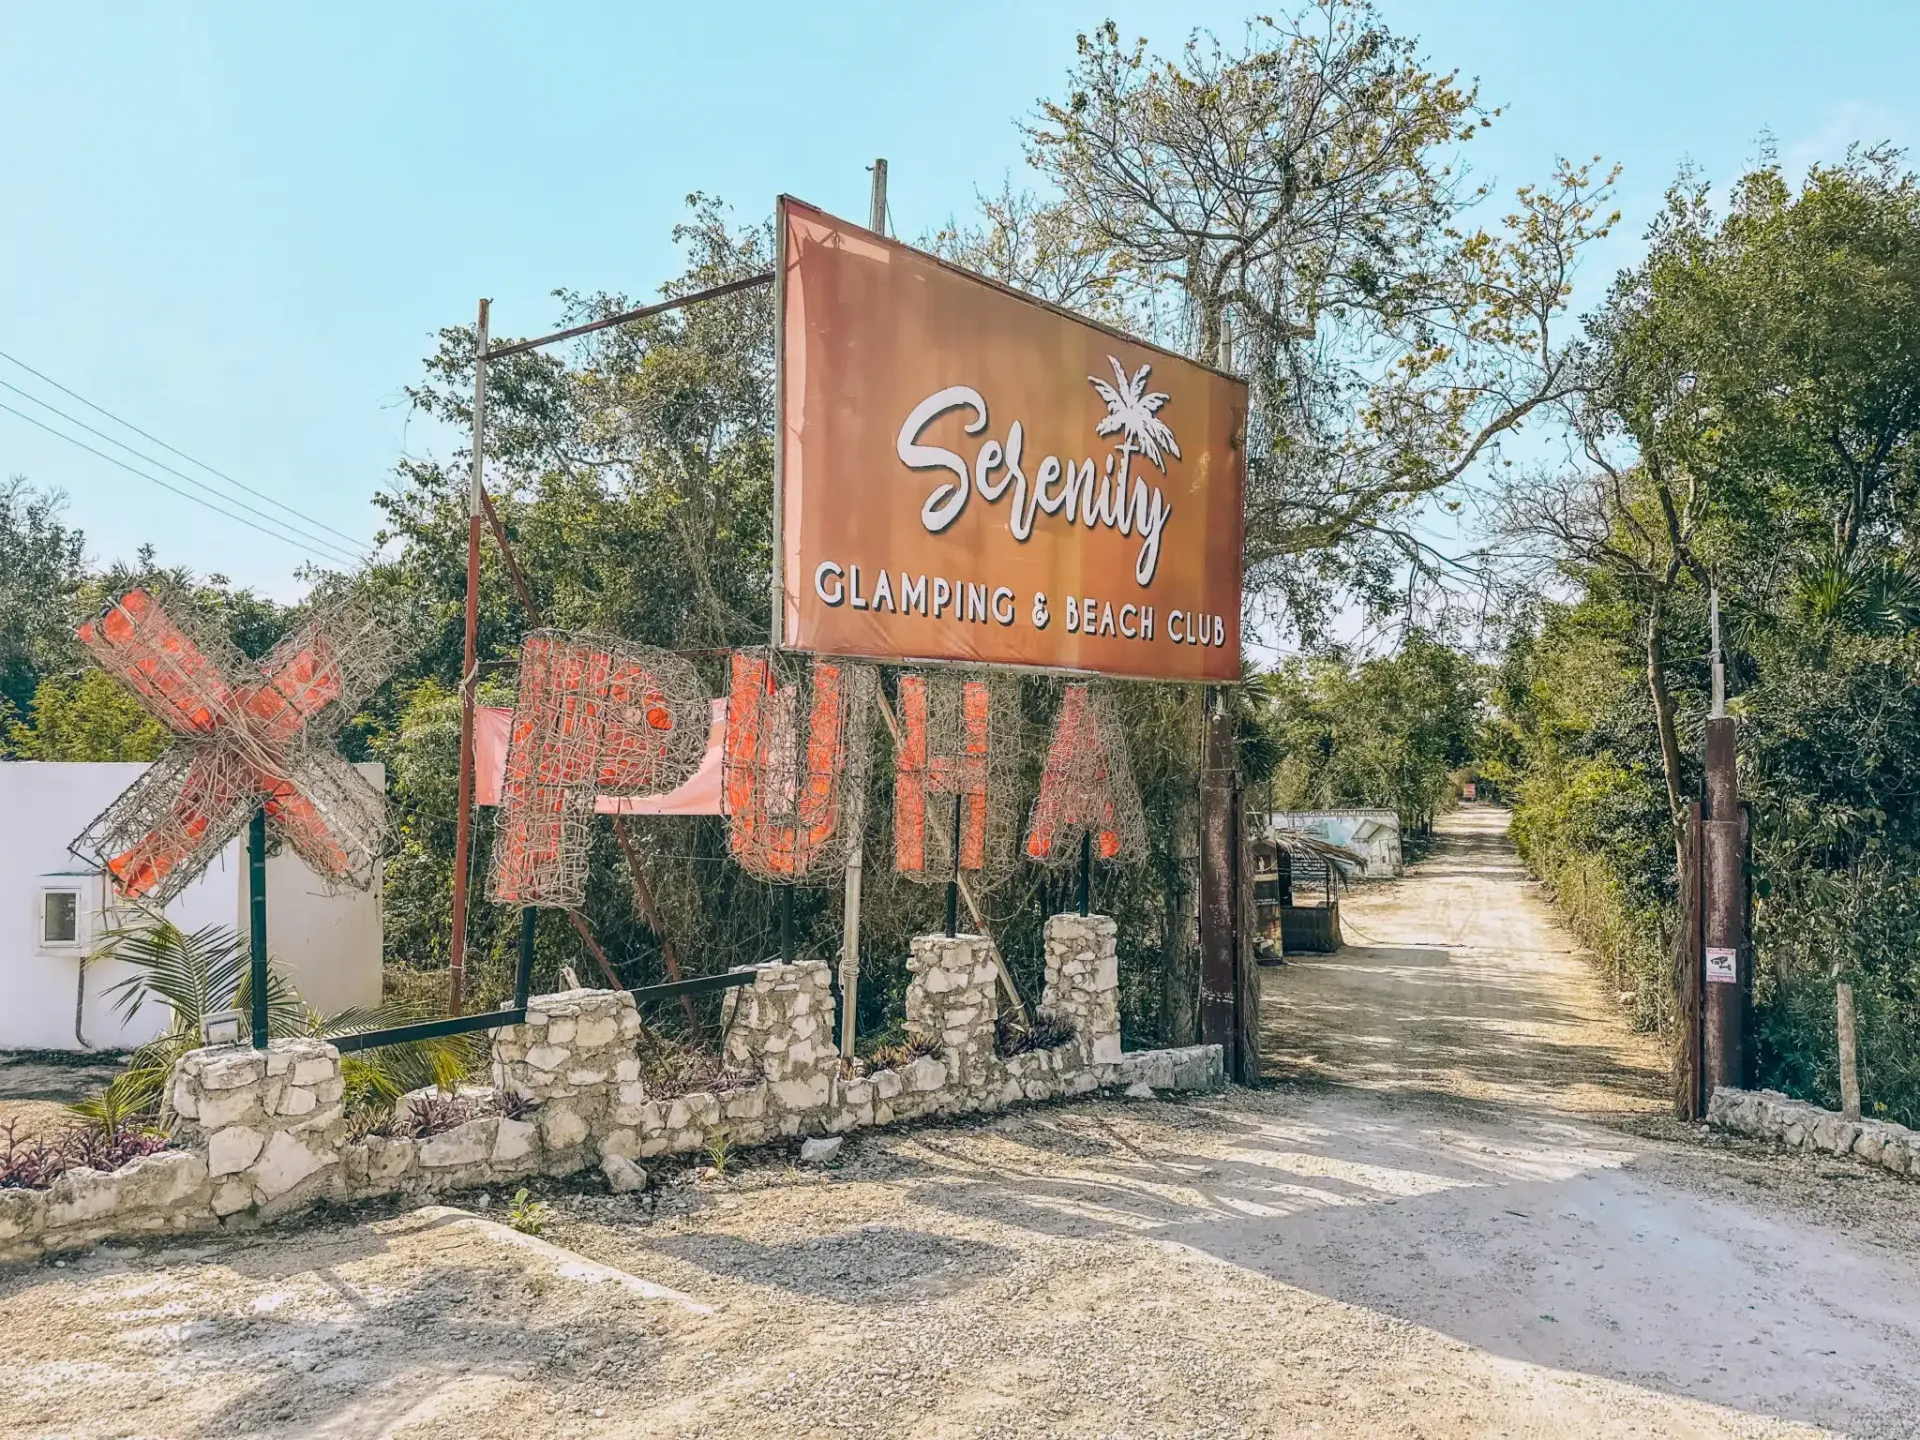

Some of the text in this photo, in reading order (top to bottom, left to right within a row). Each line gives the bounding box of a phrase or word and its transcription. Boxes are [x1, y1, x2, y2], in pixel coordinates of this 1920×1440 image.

[897, 385, 1171, 586] Serenity
[814, 560, 1227, 648] GLAMPING & BEACH CLUB
